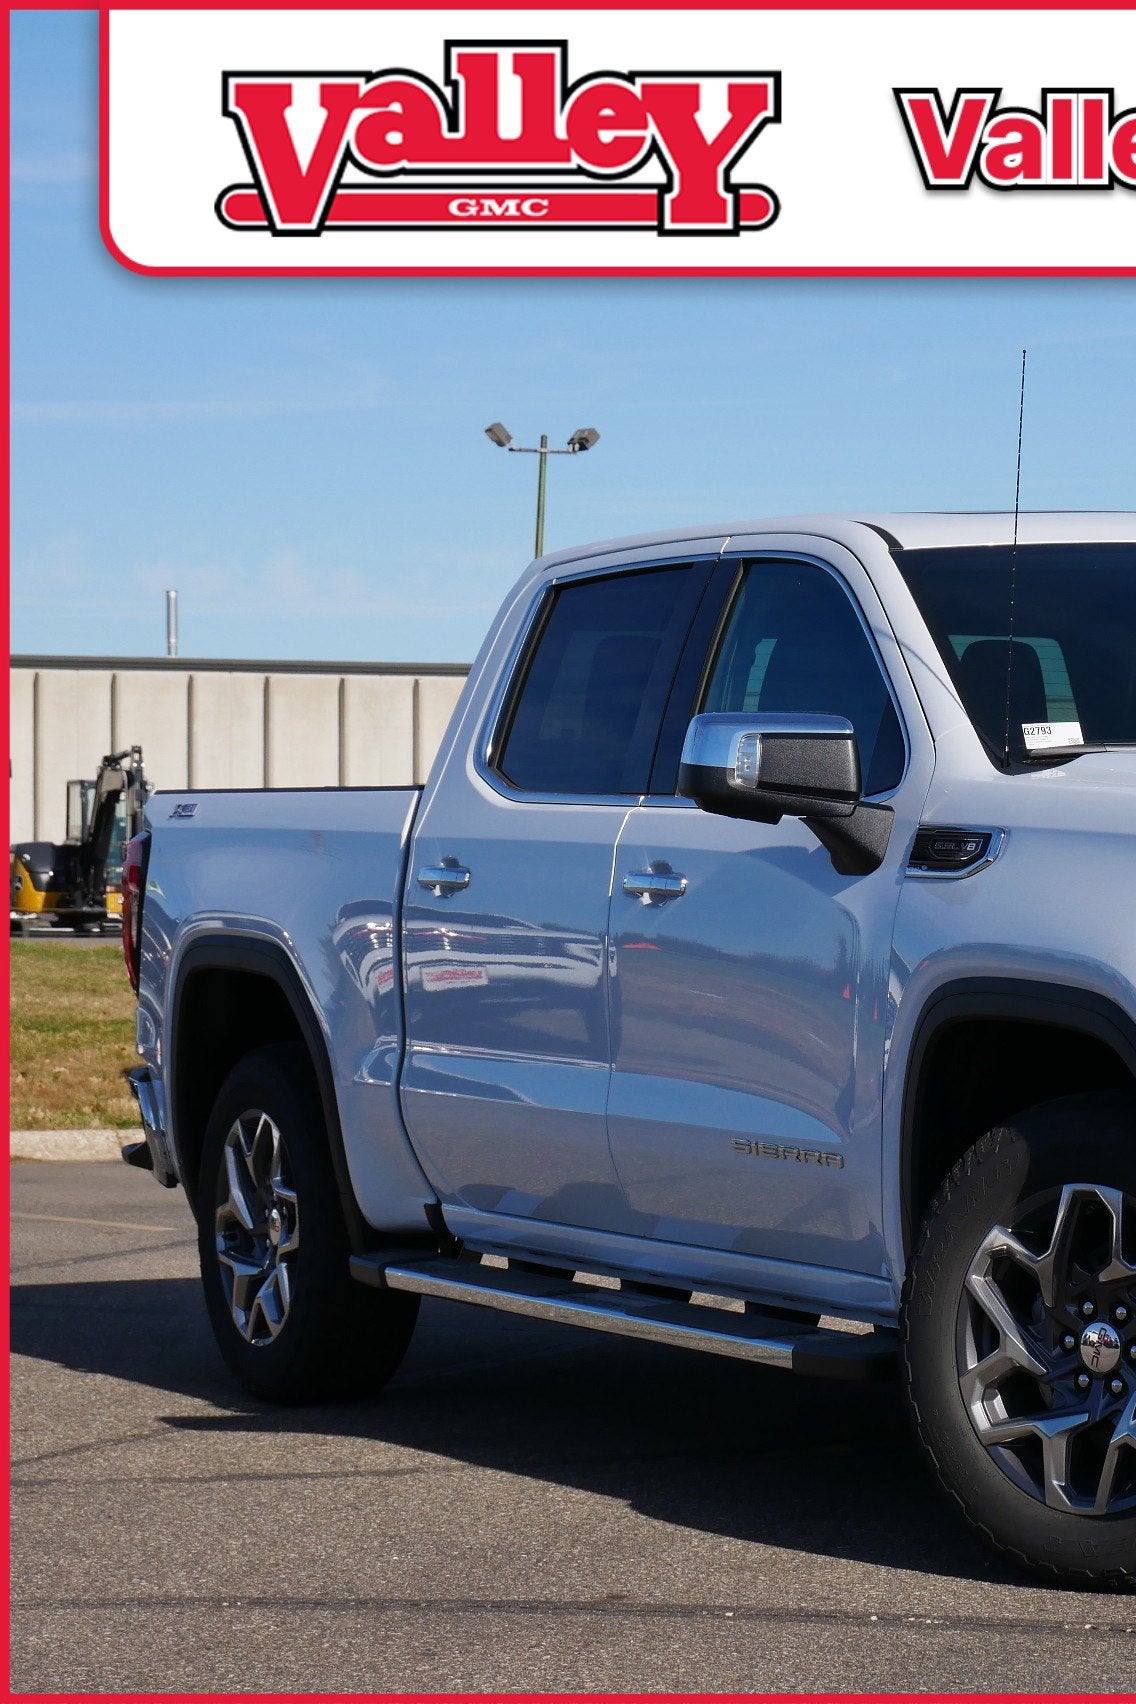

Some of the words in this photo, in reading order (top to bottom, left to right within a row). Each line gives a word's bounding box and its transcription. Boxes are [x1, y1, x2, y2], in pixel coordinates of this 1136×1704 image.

[1023, 726, 1052, 736] G2793
[728, 1138, 845, 1169] SIERRA
[1090, 1326, 1107, 1368] GMC
